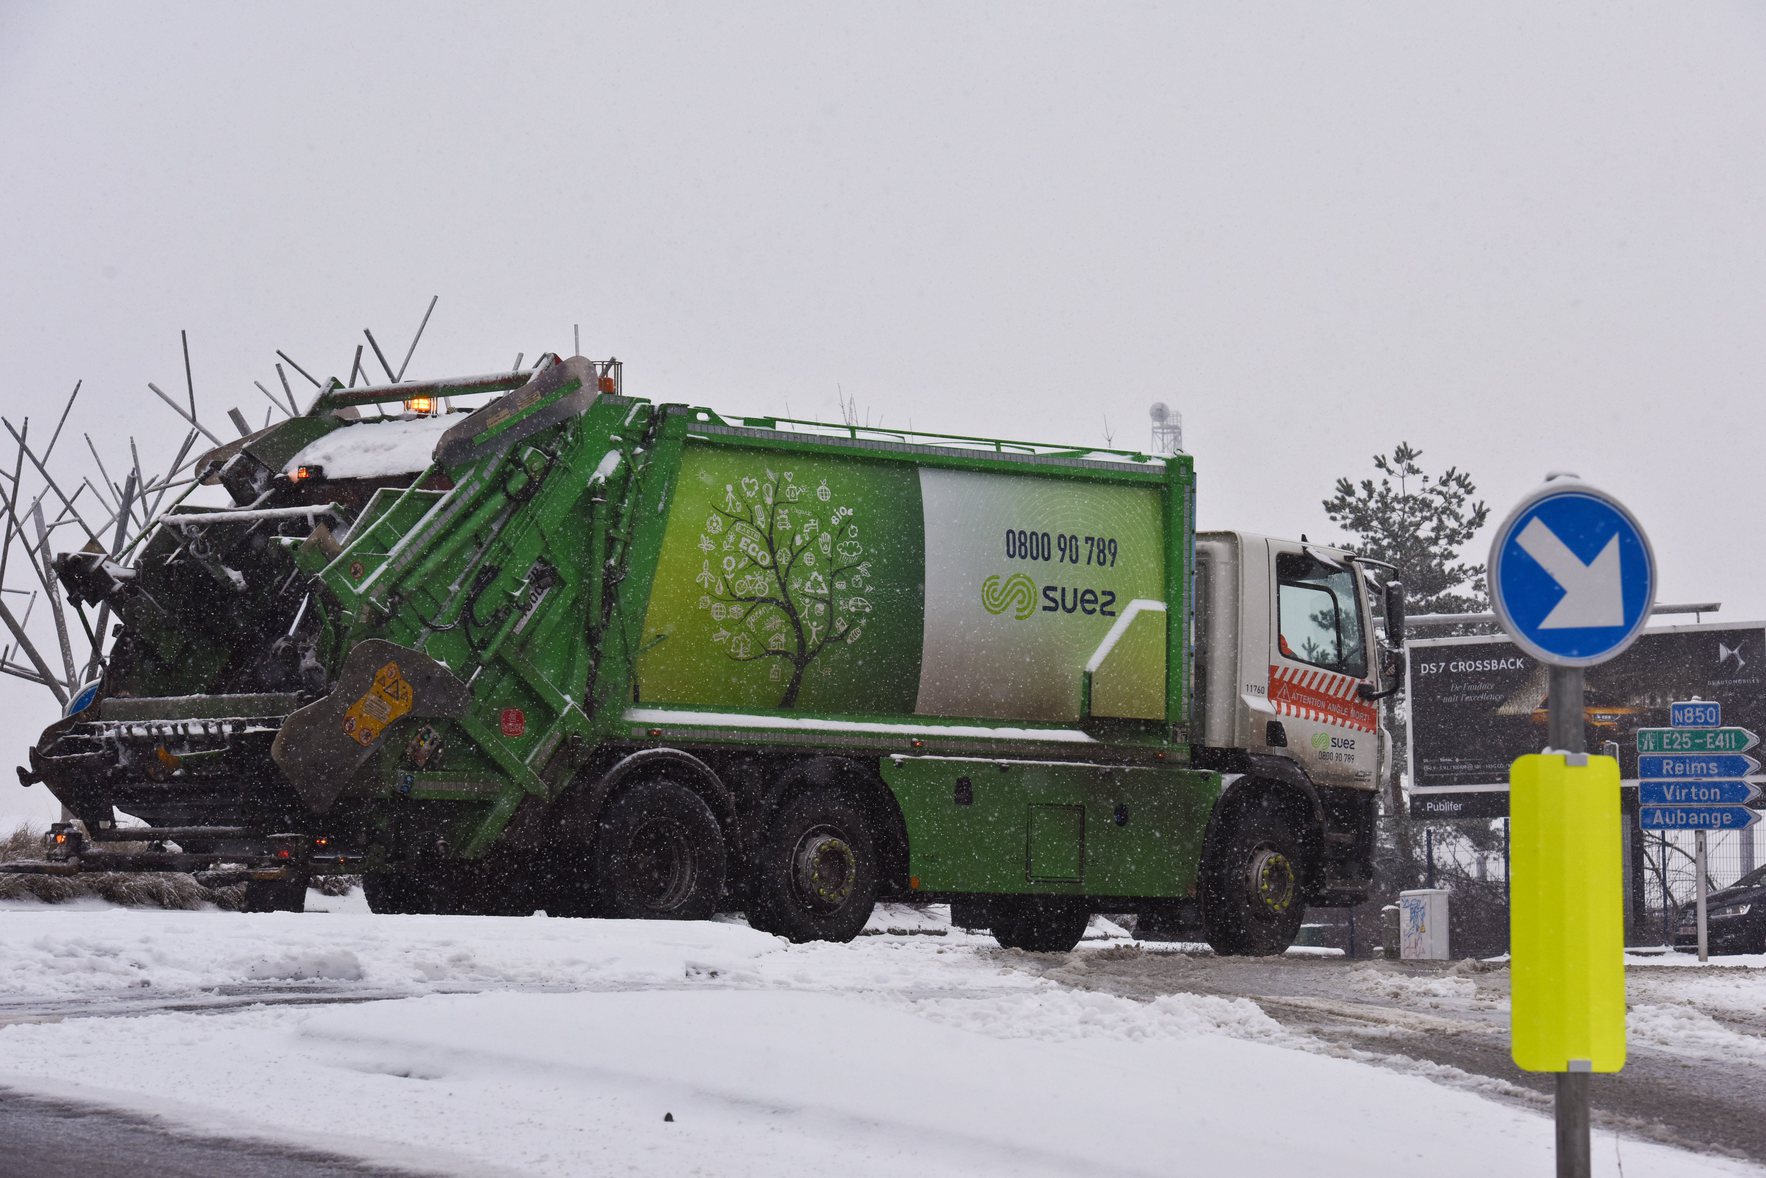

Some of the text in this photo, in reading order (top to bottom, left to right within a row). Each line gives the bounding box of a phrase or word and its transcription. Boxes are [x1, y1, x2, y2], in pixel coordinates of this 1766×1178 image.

[739, 537, 770, 566] ECO
[1006, 529, 1118, 567] 0800 90 789
[1449, 658, 1525, 673] CROSSBACK
[1246, 684, 1265, 695] 11760
[1291, 692, 1326, 708] ATTENTION
[1327, 703, 1349, 716] ANGLE
[1674, 707, 1717, 723] N850
[1318, 750, 1355, 764] 0800 90 789
[1662, 759, 1719, 775] Reims
[1662, 785, 1721, 801] Virton
[1426, 801, 1463, 812] Publifer
[1652, 809, 1733, 828] Aubange
